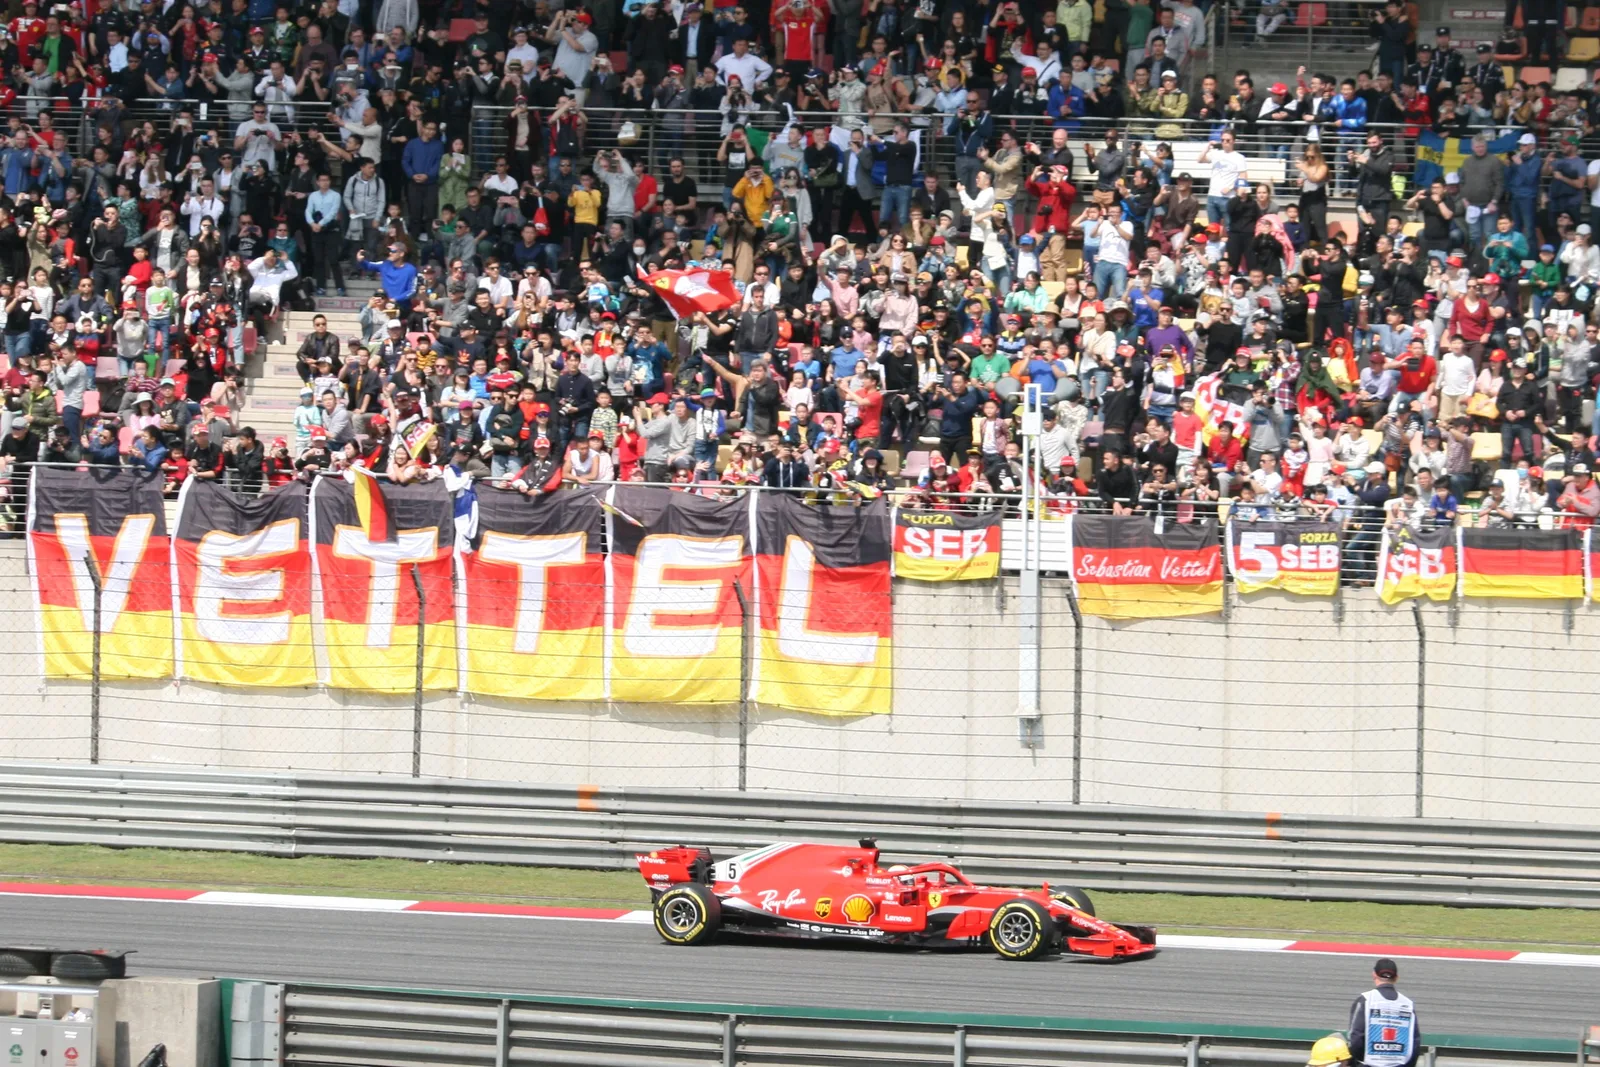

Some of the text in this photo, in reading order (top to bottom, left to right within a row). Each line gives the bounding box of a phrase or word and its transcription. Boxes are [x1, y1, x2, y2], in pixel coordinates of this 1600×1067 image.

[902, 526, 988, 561] SEB
[1299, 532, 1338, 544] FORZA
[1076, 551, 1218, 579] Sebastian Vettel
[1239, 531, 1279, 584] 5
[1280, 543, 1340, 569] SEB
[53, 512, 880, 665] VETTEL
[728, 862, 737, 880] 5
[757, 888, 807, 915] Ray-Ban
[884, 913, 912, 923] Lenovo
